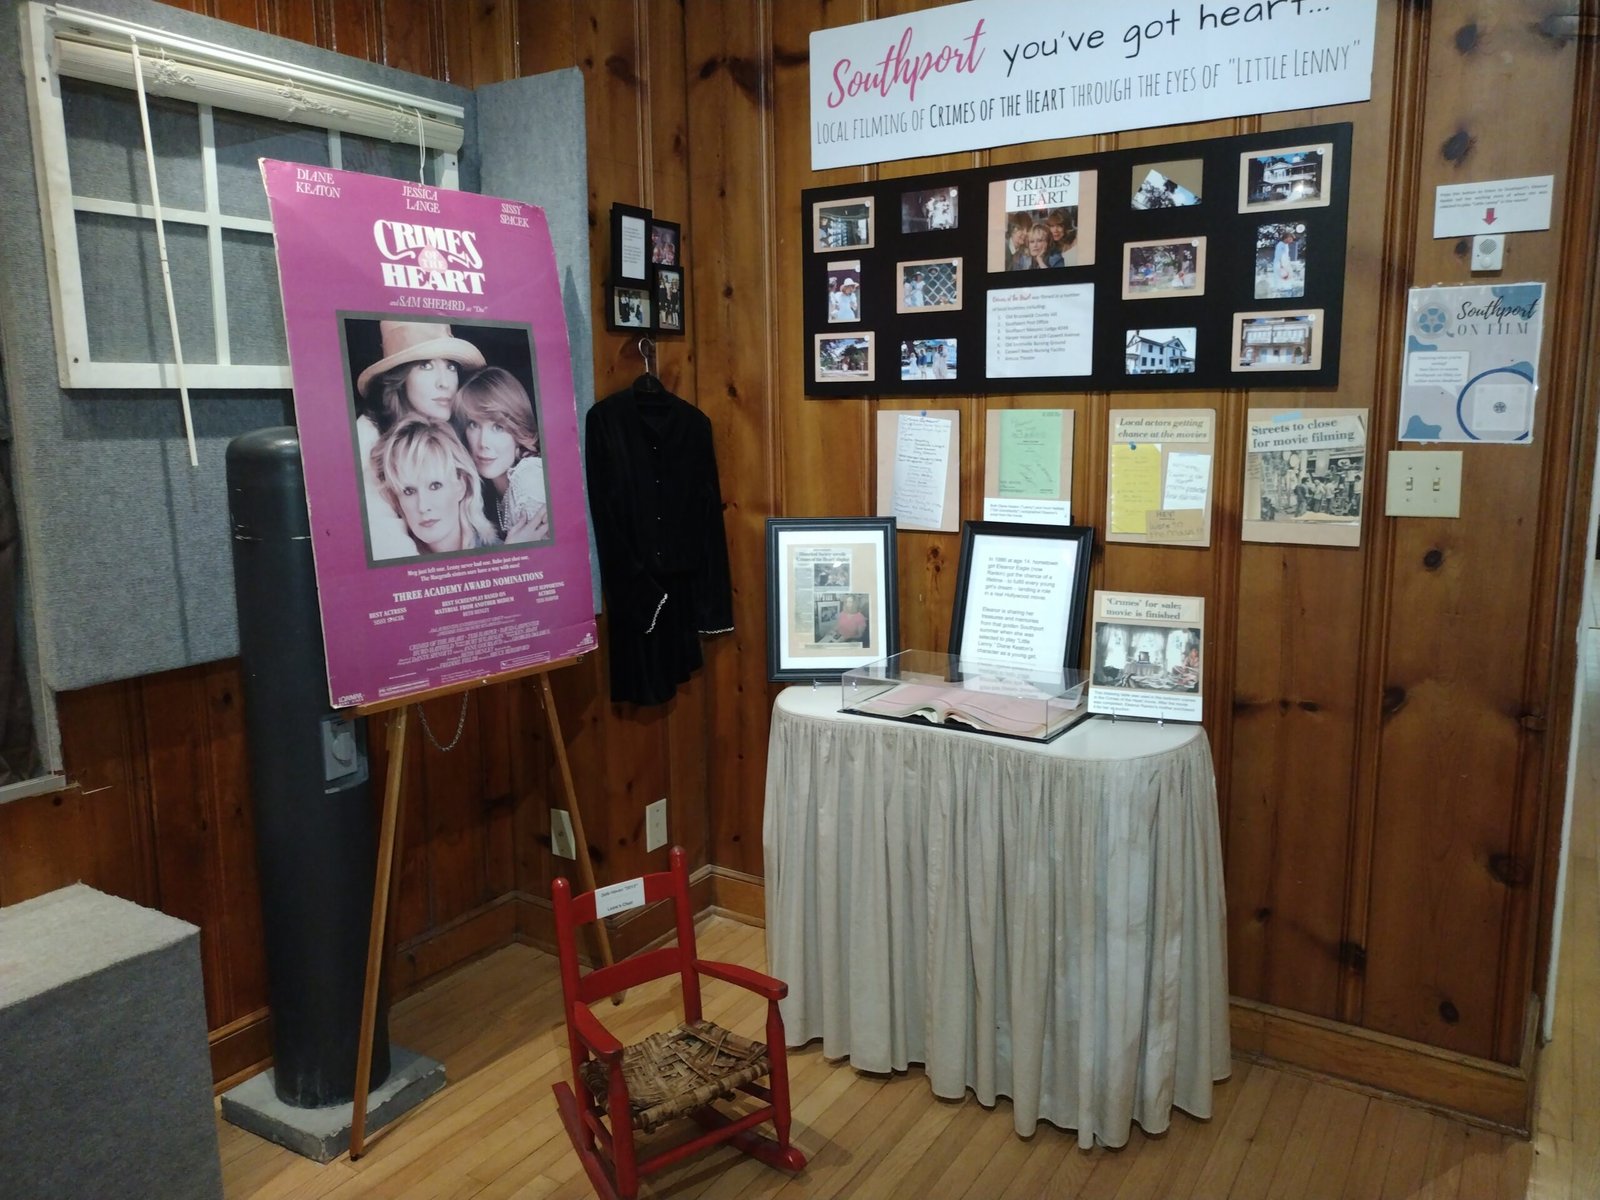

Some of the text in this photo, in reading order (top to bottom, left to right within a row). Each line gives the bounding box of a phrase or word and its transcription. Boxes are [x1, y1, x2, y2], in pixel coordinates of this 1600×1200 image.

[827, 18, 986, 109] Southport
[1003, 29, 1104, 77] you've
[1123, 9, 1180, 58] got
[817, 120, 849, 144] LOCAL
[853, 111, 908, 139] FILMING
[912, 108, 925, 131] OF
[930, 101, 976, 128] CRIMES
[980, 98, 995, 120] OF
[1000, 93, 1021, 117] THE
[1026, 87, 1066, 113] HEART
[1071, 76, 1132, 107] THROUGH
[1138, 73, 1160, 98] THE
[1166, 66, 1197, 94] EYES
[1202, 63, 1220, 89] OF
[296, 168, 335, 185] DIANE
[1013, 174, 1071, 193] CRIMES
[295, 181, 341, 199] KEATON
[401, 185, 438, 201] JESSICA
[406, 198, 440, 214] LANGE
[1016, 190, 1067, 208] HEART
[501, 203, 522, 215] SISSY
[499, 214, 529, 228] SPACEK
[373, 219, 483, 269] CRIMES
[380, 262, 486, 295] HEART
[399, 295, 421, 308] SAM
[422, 296, 465, 312] SHEPARD
[1457, 296, 1541, 323] Southport
[1457, 322, 1528, 336] ON FILM
[1120, 417, 1204, 429] Local actors getting
[1251, 418, 1338, 436] Streets to close
[1118, 429, 1148, 438] chance
[1160, 430, 1174, 438] the
[1176, 430, 1207, 438] movies
[1253, 430, 1355, 448] for movie filming
[393, 571, 544, 603] THREE ACADEMY AWARD NOMINATIONS
[1145, 599, 1158, 609] for
[1106, 608, 1181, 620] movie is finished
